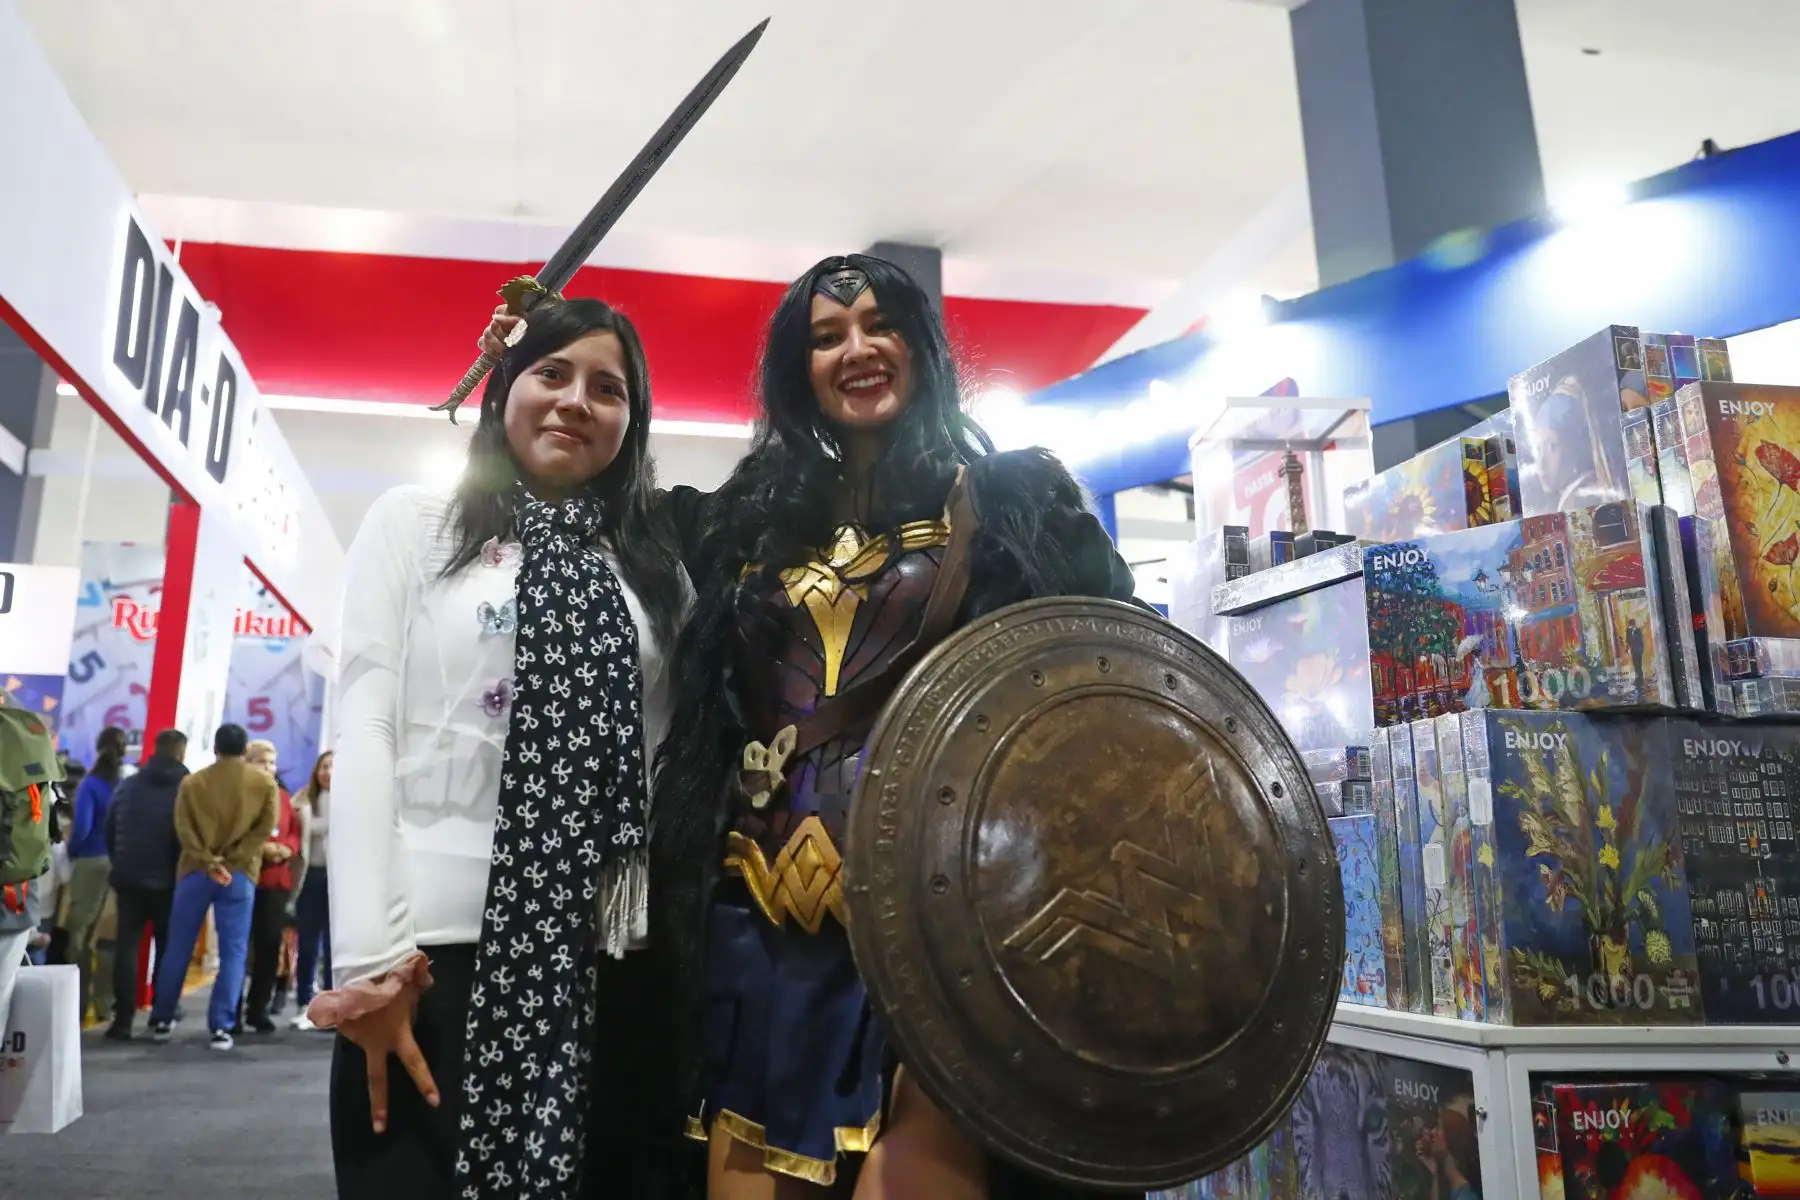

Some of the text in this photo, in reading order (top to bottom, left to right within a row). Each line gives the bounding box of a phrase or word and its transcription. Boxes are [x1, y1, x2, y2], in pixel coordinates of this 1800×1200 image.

[113, 213, 237, 485] DIA-D
[1719, 399, 1774, 417] ENJOY
[1373, 548, 1430, 571] ENJOY
[1233, 618, 1262, 637] ENJOY
[1493, 666, 1591, 709] 1000
[246, 697, 275, 732] 5
[1504, 731, 1567, 750] ENJOY
[1684, 738, 1742, 757] ENJOY
[1564, 973, 1652, 1010] 1000
[1395, 1078, 1439, 1104] ENJOY
[1573, 1109, 1631, 1130] ENJOY
